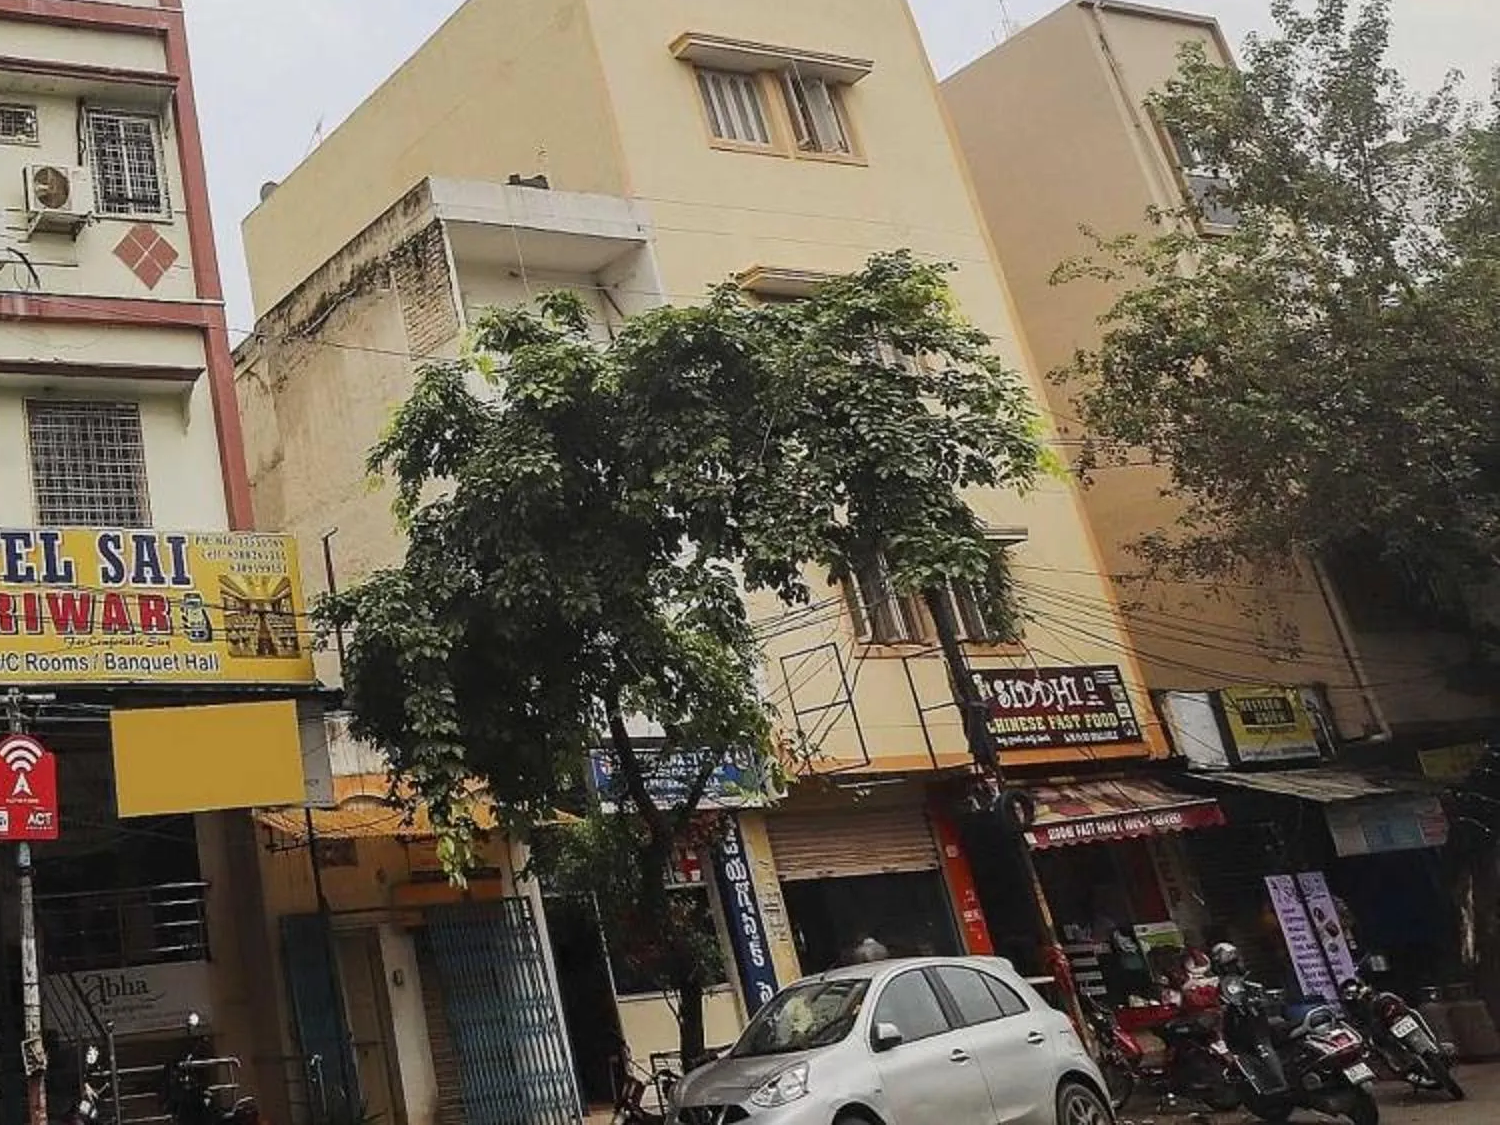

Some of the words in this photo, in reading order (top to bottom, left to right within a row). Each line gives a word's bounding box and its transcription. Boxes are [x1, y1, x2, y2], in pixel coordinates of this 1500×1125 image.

[97, 532, 192, 586] SAI
[25, 652, 89, 672] Rooms
[104, 653, 181, 674] Banquet
[185, 653, 219, 671] Hall
[1050, 712, 1082, 730] FAST
[1084, 711, 1119, 729] FOOD
[27, 812, 53, 826] ACT
